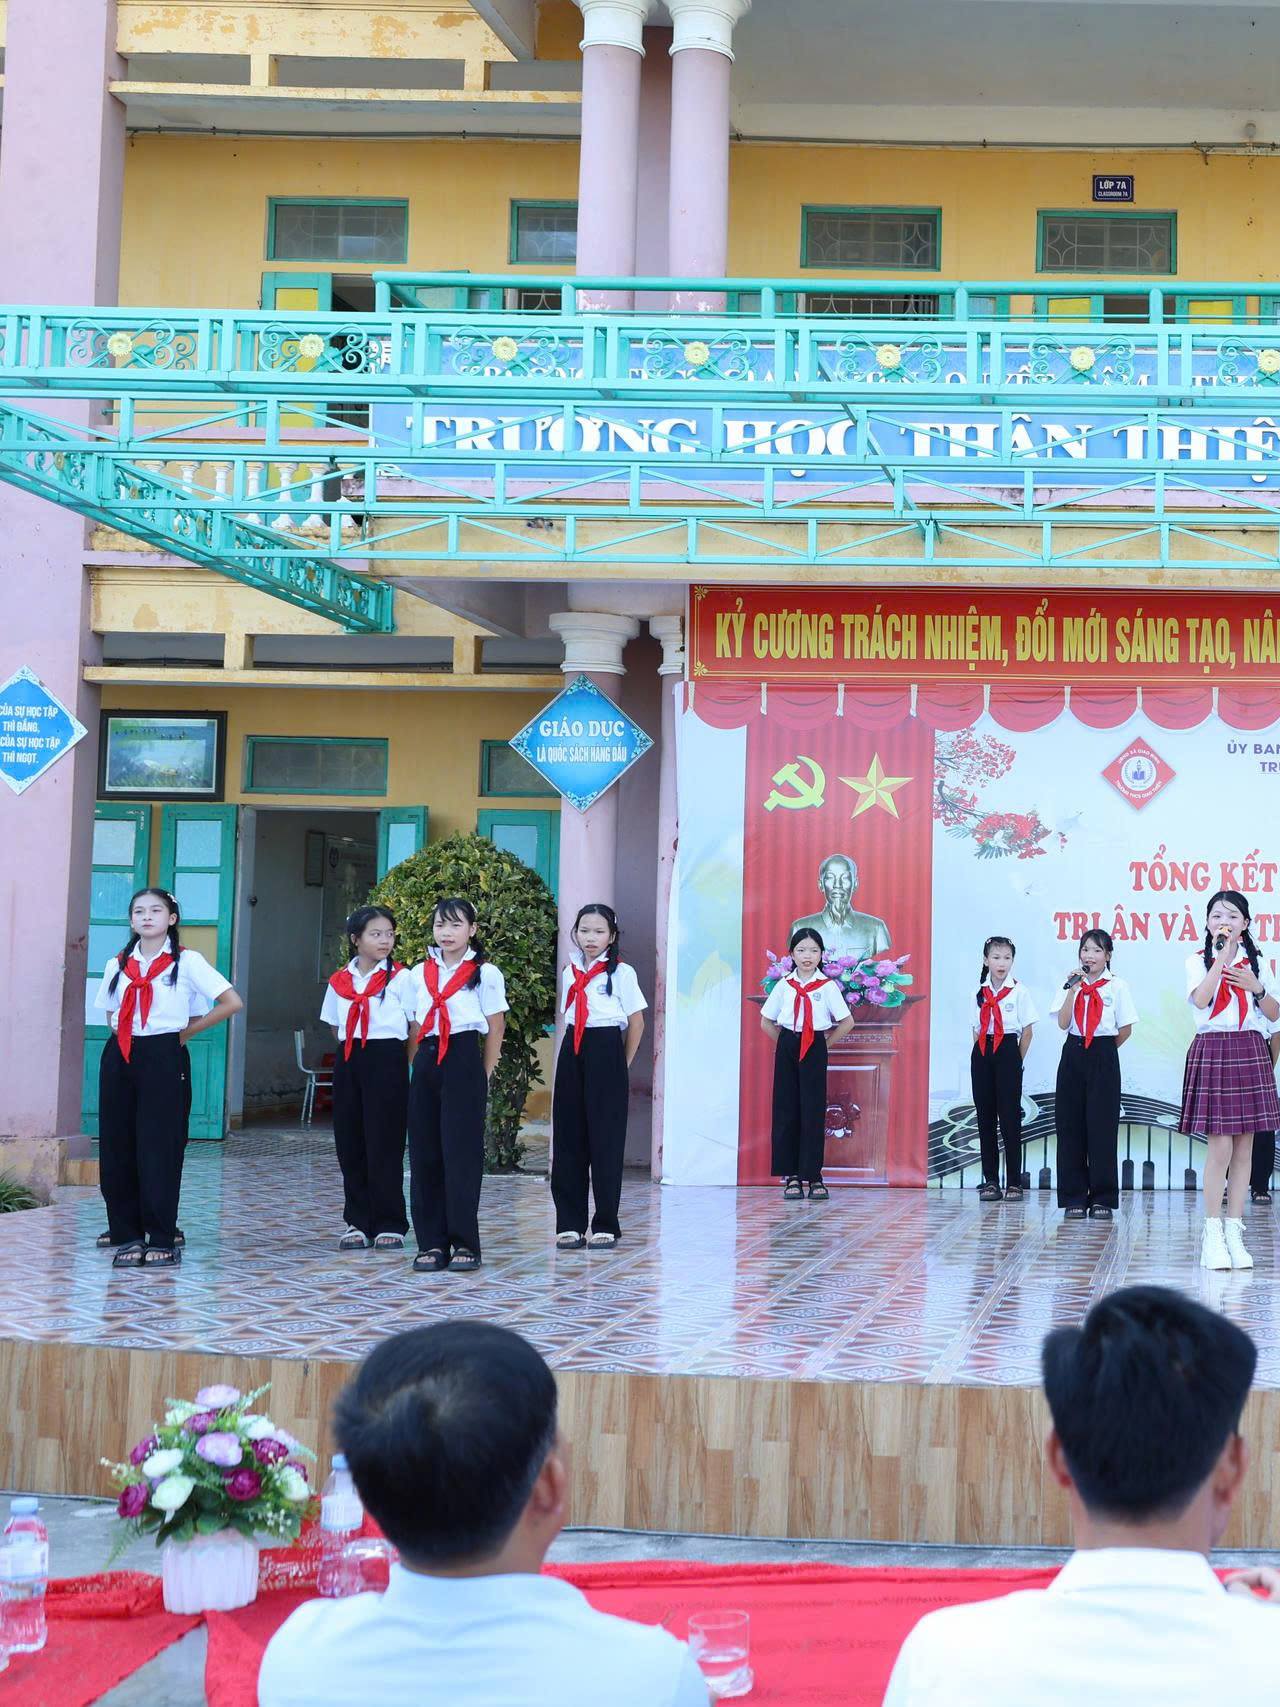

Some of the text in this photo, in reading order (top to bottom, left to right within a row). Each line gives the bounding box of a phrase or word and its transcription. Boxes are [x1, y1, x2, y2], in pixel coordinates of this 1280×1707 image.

[1100, 180, 1126, 189] LỚP 7A
[899, 414, 1093, 459] THÂN
[715, 597, 747, 658] KỶ
[753, 607, 834, 660] CƯƠNG
[842, 605, 917, 660] TRÁCH
[924, 605, 1008, 671] NHIỆM,
[1015, 597, 1055, 662] ĐỔI
[1062, 606, 1108, 663] MỚI
[1115, 606, 1178, 663] SÁNG
[1186, 617, 1236, 674] TẠO,
[26, 706, 42, 718] HỌC
[539, 716, 625, 742] GIÁO DỤC
[28, 738, 44, 749] HỌC
[536, 744, 547, 762] LÀ
[548, 742, 567, 763] QUỐC
[569, 742, 589, 762] SÁCH
[1227, 739, 1248, 754] ỦY
[1129, 844, 1211, 892] TỔNG
[1220, 848, 1278, 893] KẾT
[1054, 912, 1101, 940] TRI
[1111, 904, 1150, 941] ÂN
[1159, 904, 1199, 941] VÀ
